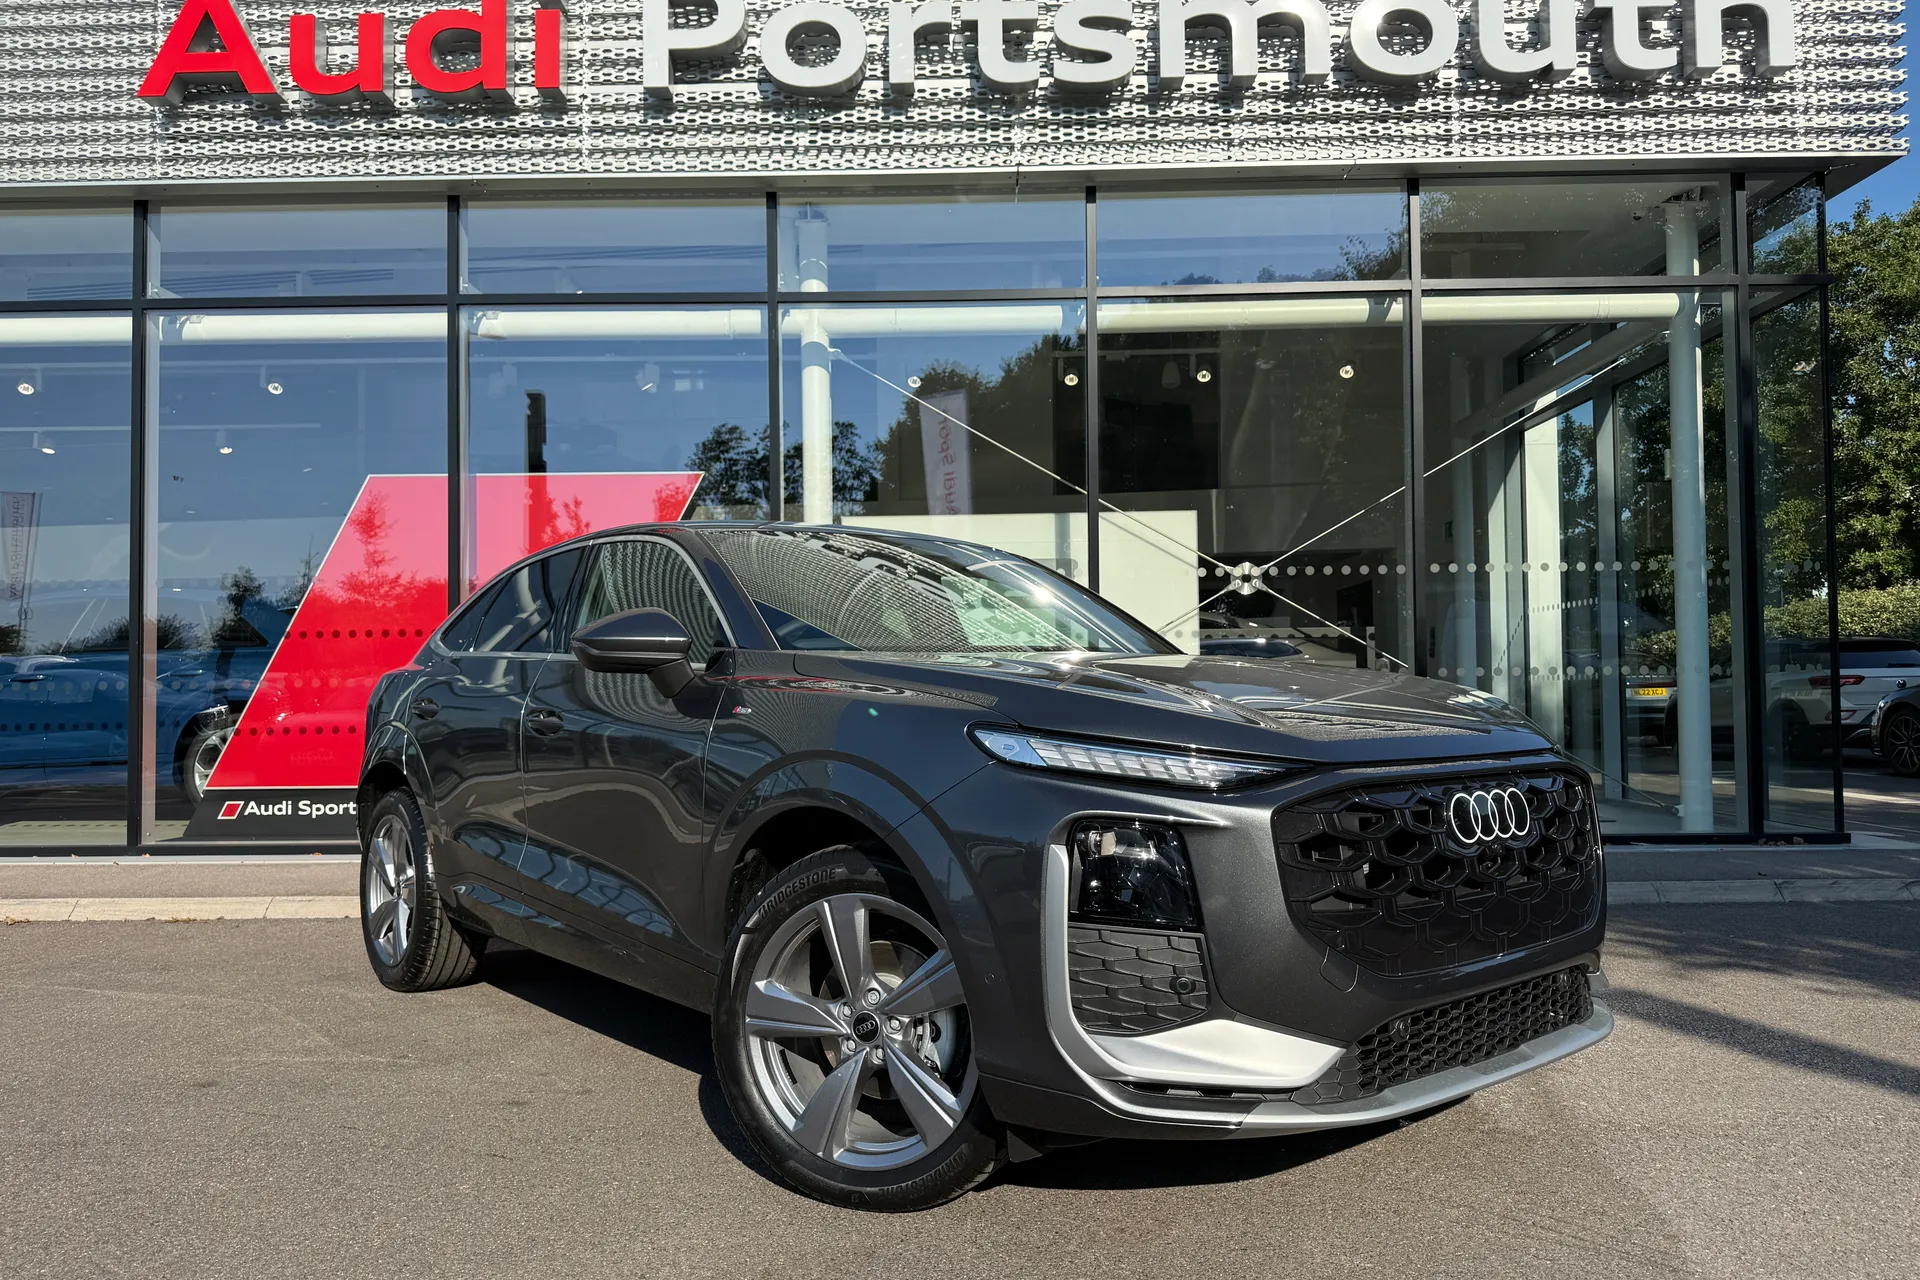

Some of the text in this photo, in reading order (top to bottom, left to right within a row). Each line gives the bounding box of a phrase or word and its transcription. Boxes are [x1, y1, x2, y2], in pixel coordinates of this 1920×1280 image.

[137, 0, 1796, 98] Audi Portsmouth
[244, 800, 357, 818] Audi Sport
[758, 867, 837, 919] BRIDGESTONE
